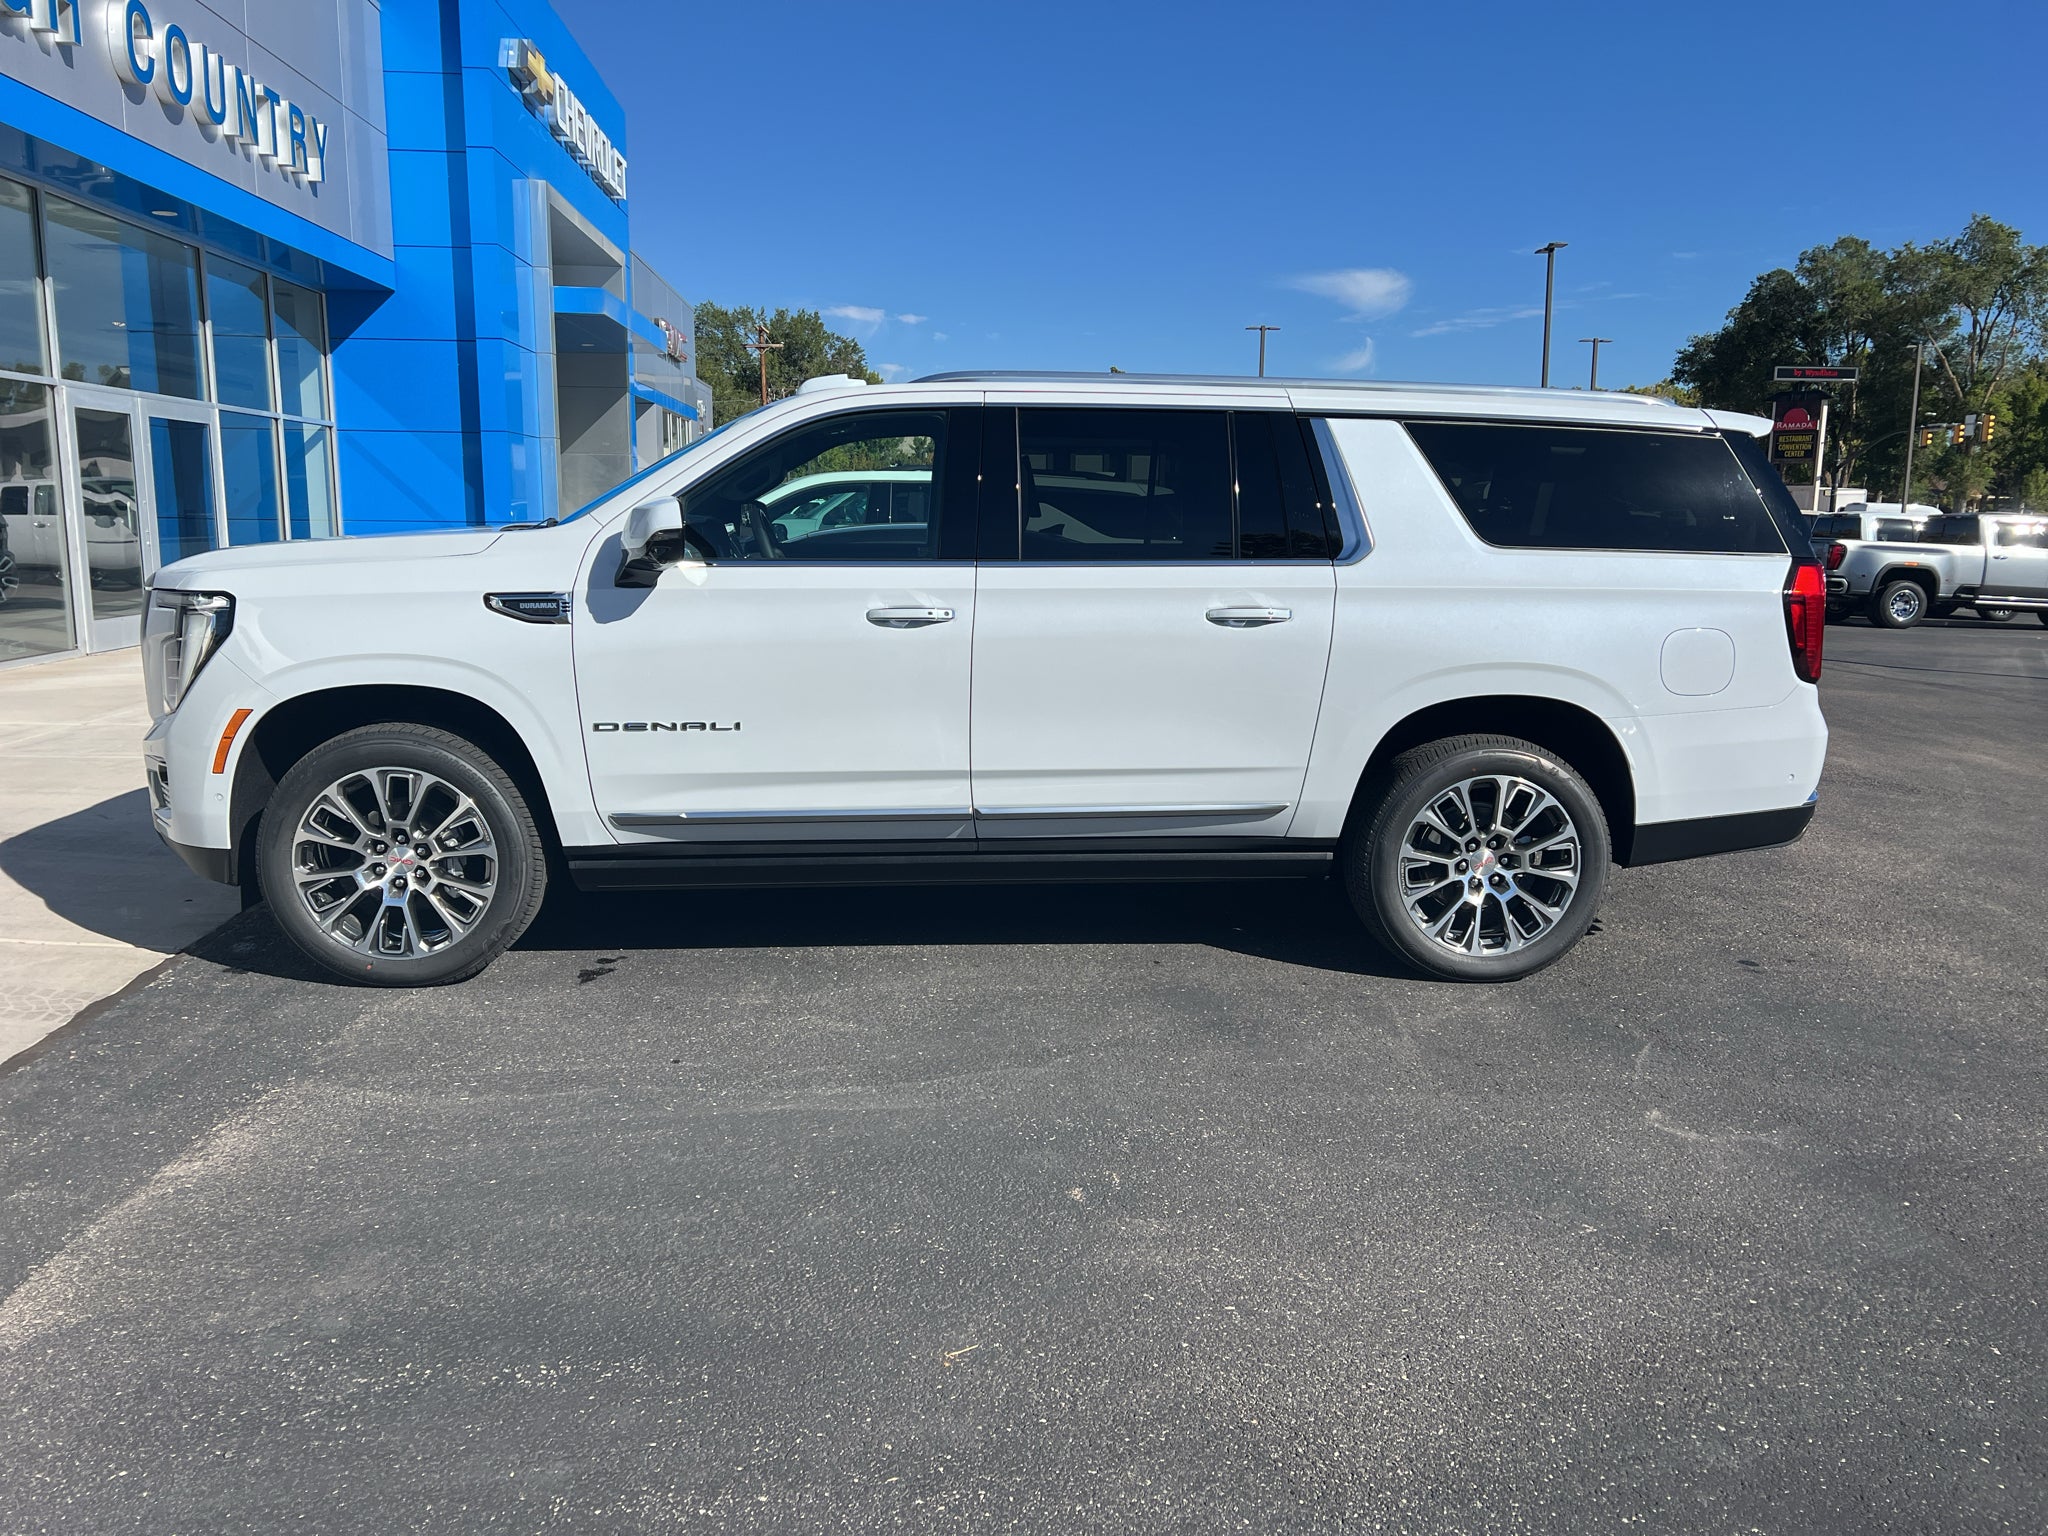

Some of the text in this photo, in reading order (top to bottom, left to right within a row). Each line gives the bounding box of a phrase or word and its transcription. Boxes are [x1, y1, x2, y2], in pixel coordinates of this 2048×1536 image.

[108, 0, 328, 183] COUNTRY
[549, 72, 627, 200] CHEVROLET
[1777, 443, 1812, 451] CONVENTION
[592, 721, 741, 732] DENALI
